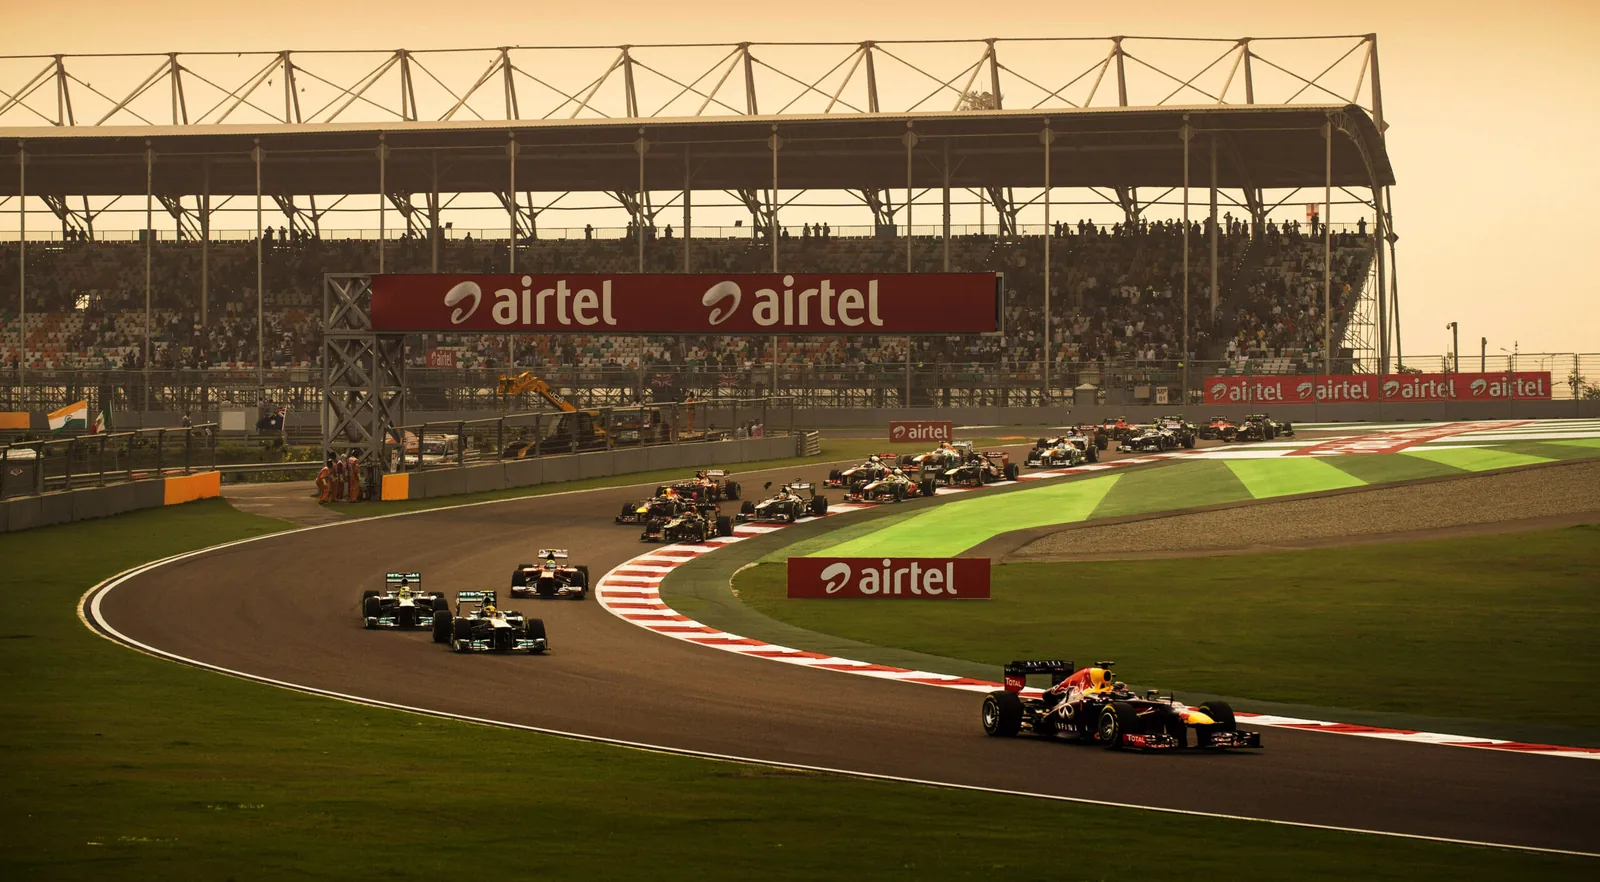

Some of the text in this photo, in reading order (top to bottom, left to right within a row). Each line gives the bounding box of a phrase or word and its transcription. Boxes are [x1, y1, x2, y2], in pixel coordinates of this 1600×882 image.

[492, 274, 884, 327] airtel airtel
[437, 350, 452, 366] airtel
[1316, 379, 1369, 400] airtel
[1401, 377, 1457, 398] airtel
[549, 390, 565, 404] JCB
[908, 424, 948, 439] airtel
[859, 558, 958, 595] airtel
[1005, 677, 1022, 687] TOTAL
[1126, 733, 1146, 743] TOTAL
